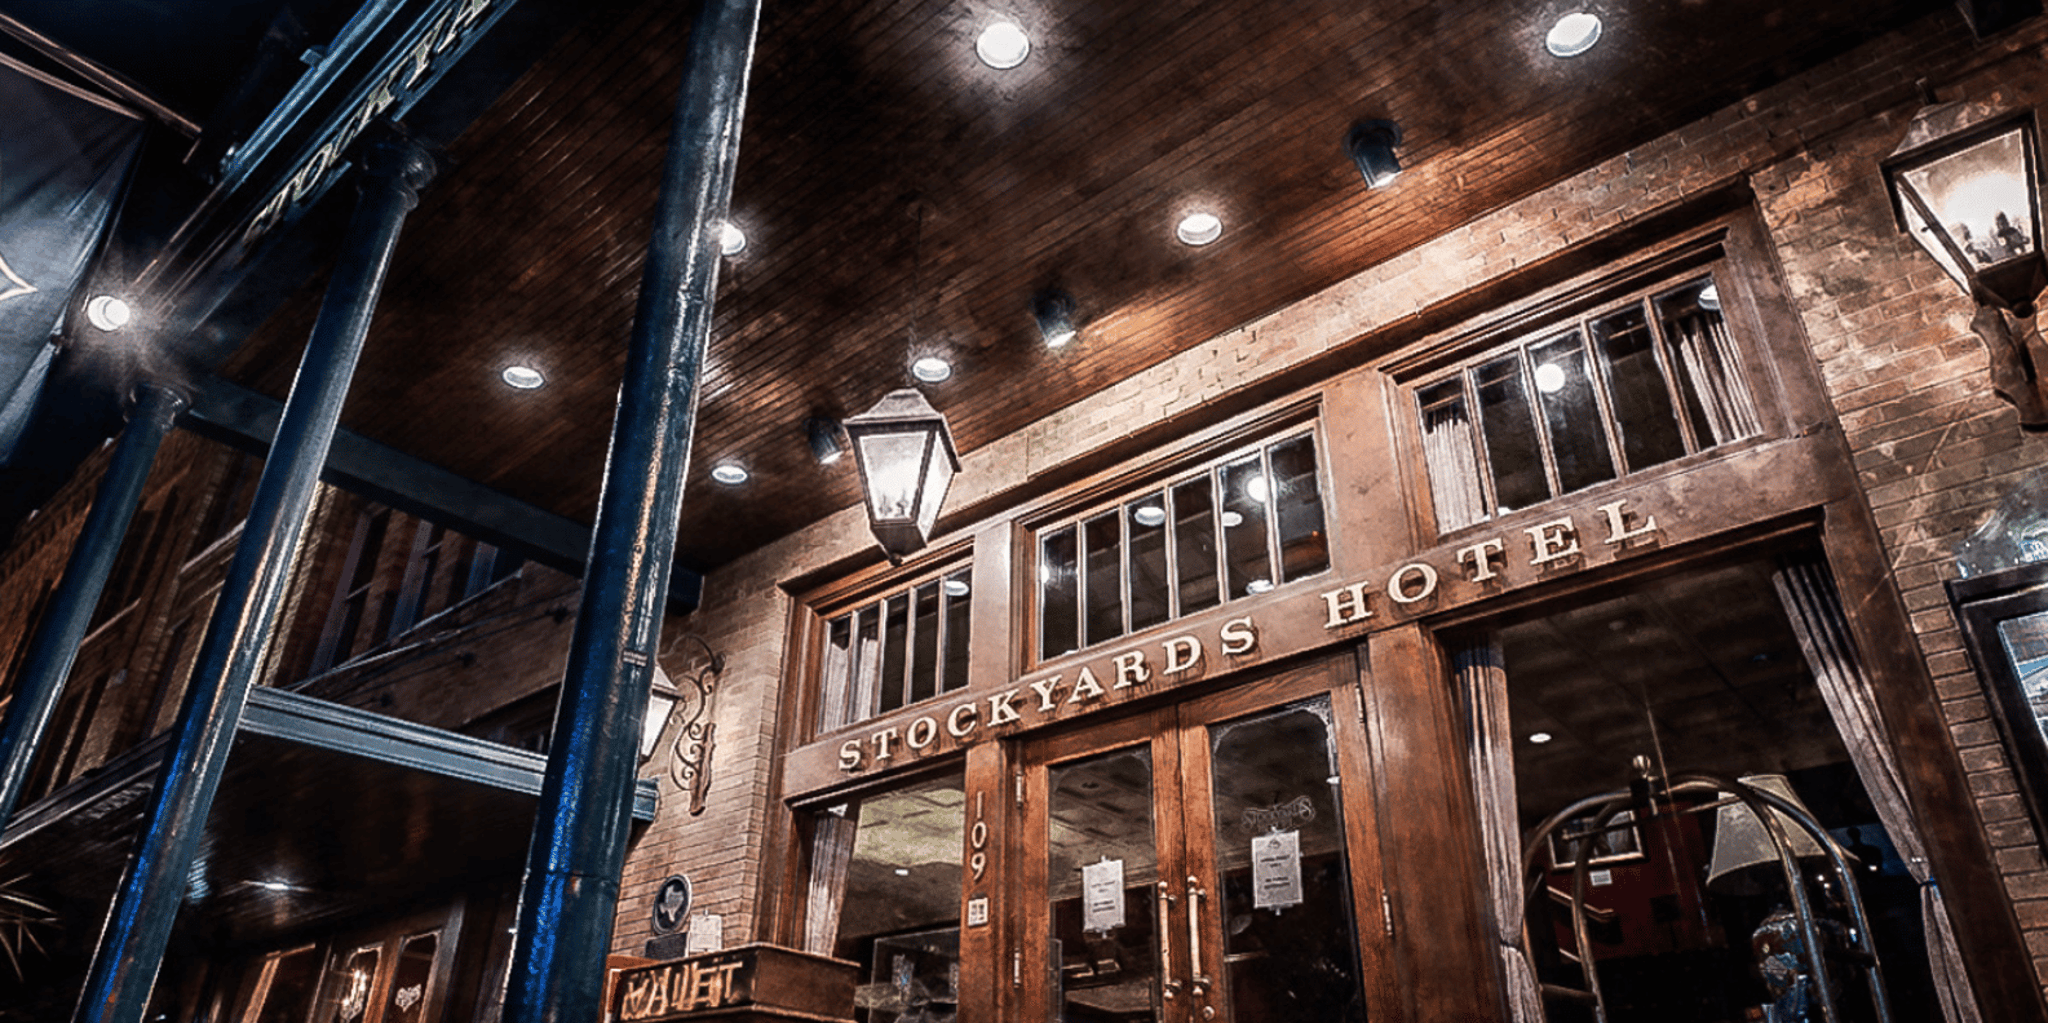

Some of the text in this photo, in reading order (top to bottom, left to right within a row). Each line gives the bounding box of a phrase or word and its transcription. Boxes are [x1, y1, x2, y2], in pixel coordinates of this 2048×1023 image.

[839, 499, 1657, 771] STOCKYARDS HOTEL
[971, 791, 987, 881] 109
